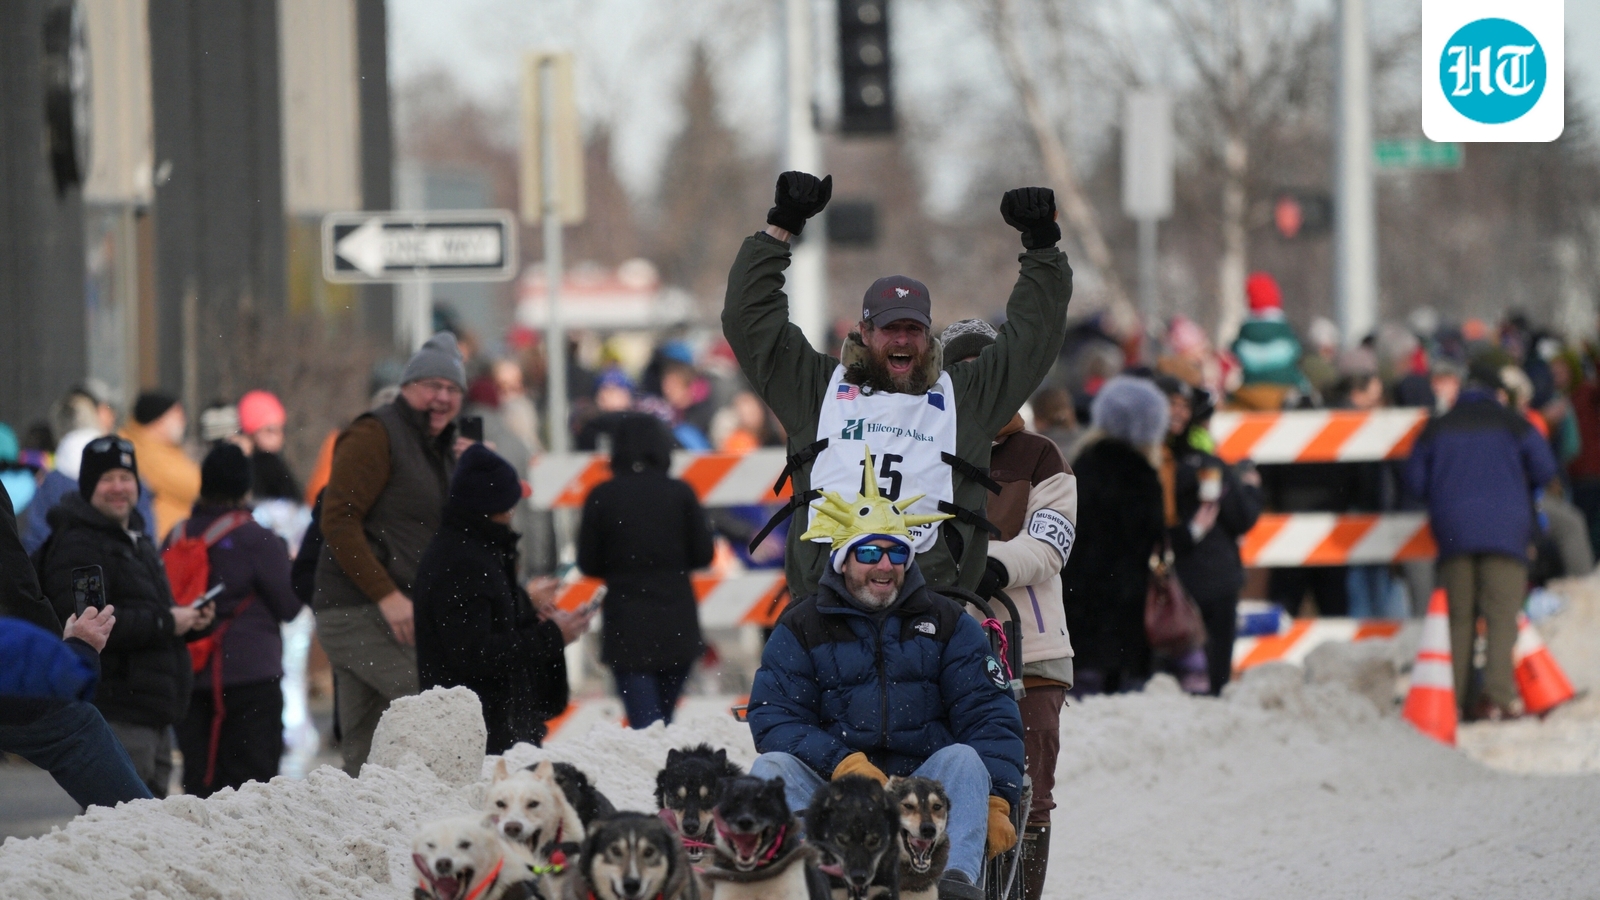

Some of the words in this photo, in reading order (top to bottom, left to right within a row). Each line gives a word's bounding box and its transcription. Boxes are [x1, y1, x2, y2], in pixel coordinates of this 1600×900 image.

[867, 423, 903, 437] Hilcorp
[1036, 512, 1064, 527] MUSHER
[1045, 524, 1071, 558] 202
